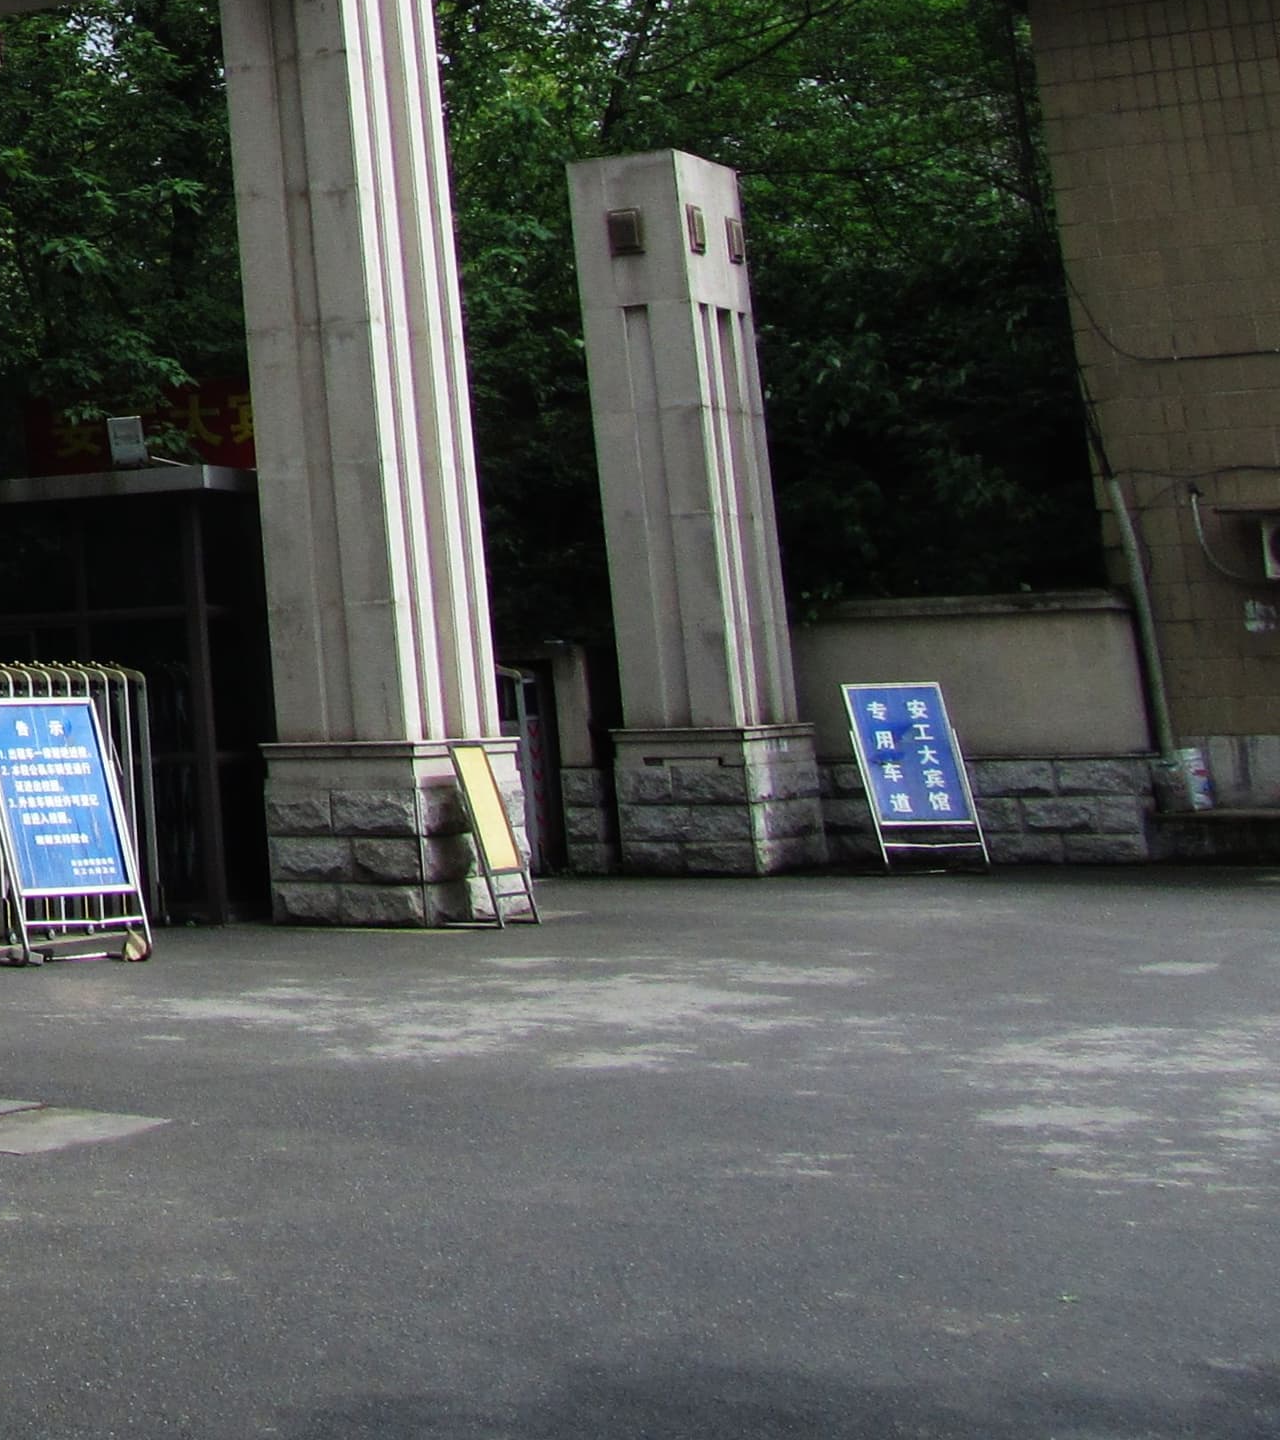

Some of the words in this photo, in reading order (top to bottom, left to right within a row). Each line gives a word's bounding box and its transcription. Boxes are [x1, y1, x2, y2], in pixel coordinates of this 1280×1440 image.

[866, 701, 913, 813] 专用车道
[906, 699, 951, 812] 安工大宾馆
